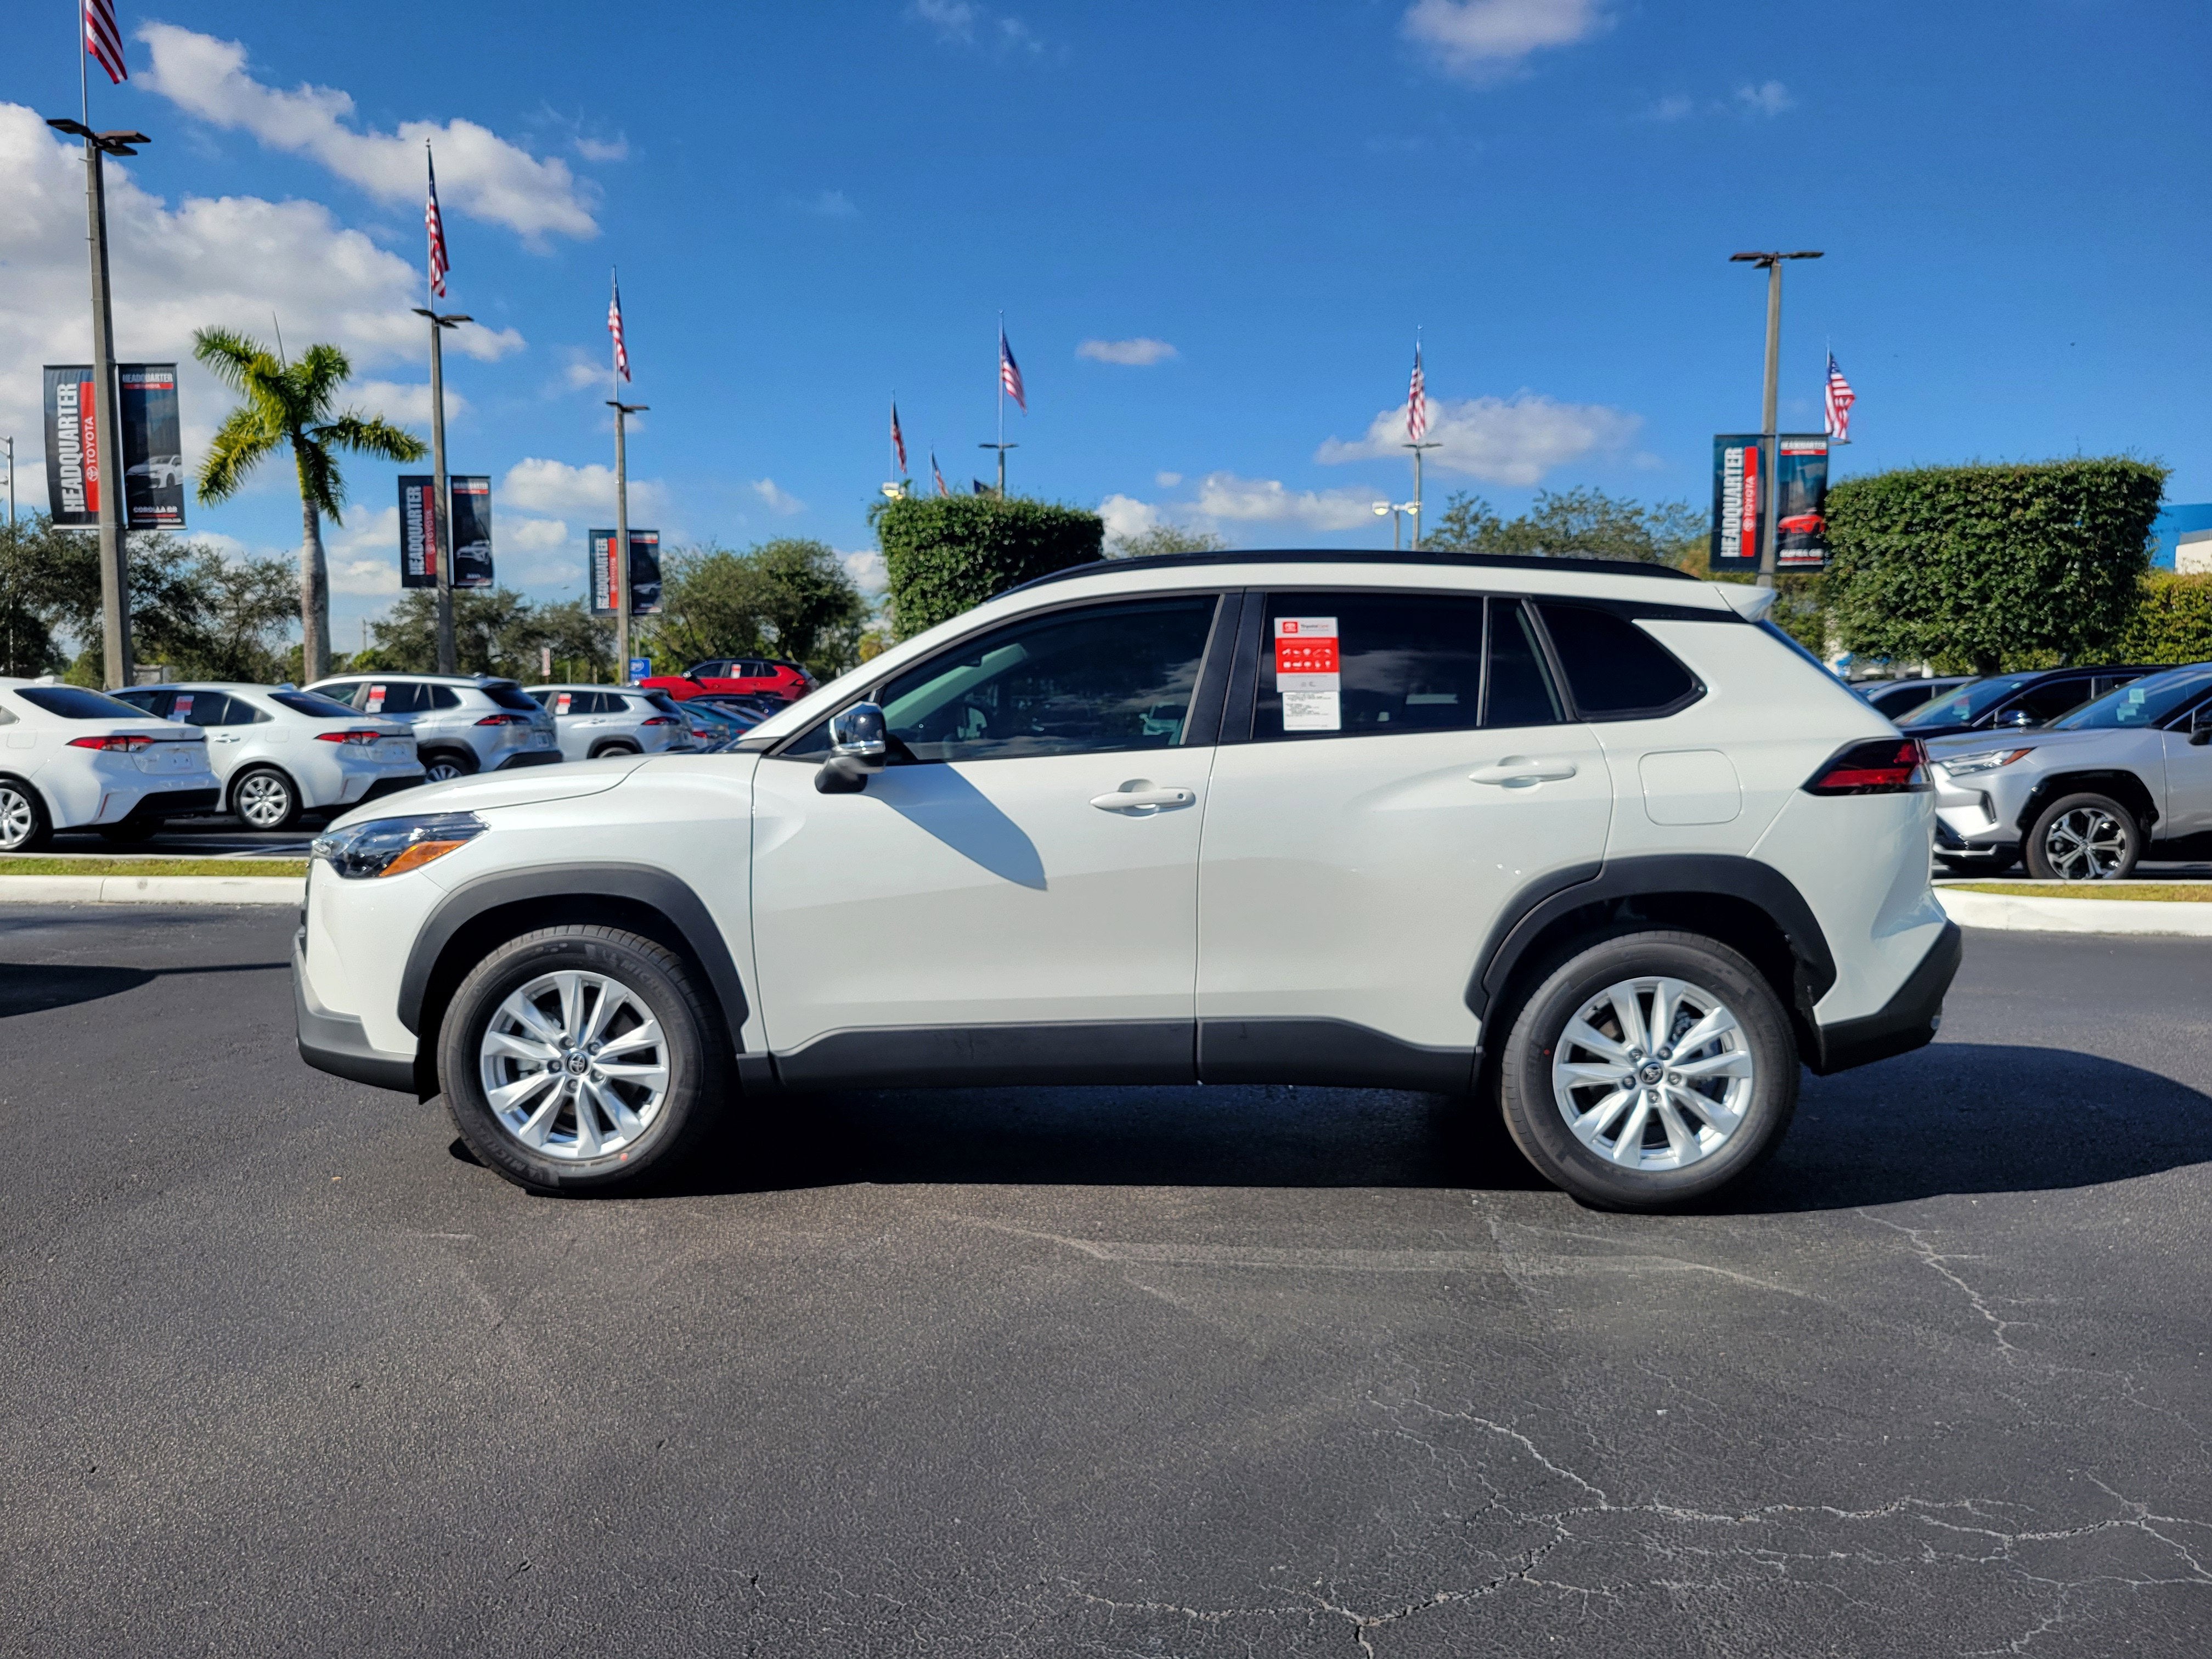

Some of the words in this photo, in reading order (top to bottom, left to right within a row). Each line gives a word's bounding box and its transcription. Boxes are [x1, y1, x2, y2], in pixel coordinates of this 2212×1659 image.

[57, 383, 86, 512] HEADQUARTER
[84, 416, 97, 464] TOYOTA
[406, 486, 426, 575] HEADQUARTER
[1720, 447, 1743, 557] HEADQUARTER
[1743, 475, 1756, 520] TOYOTA
